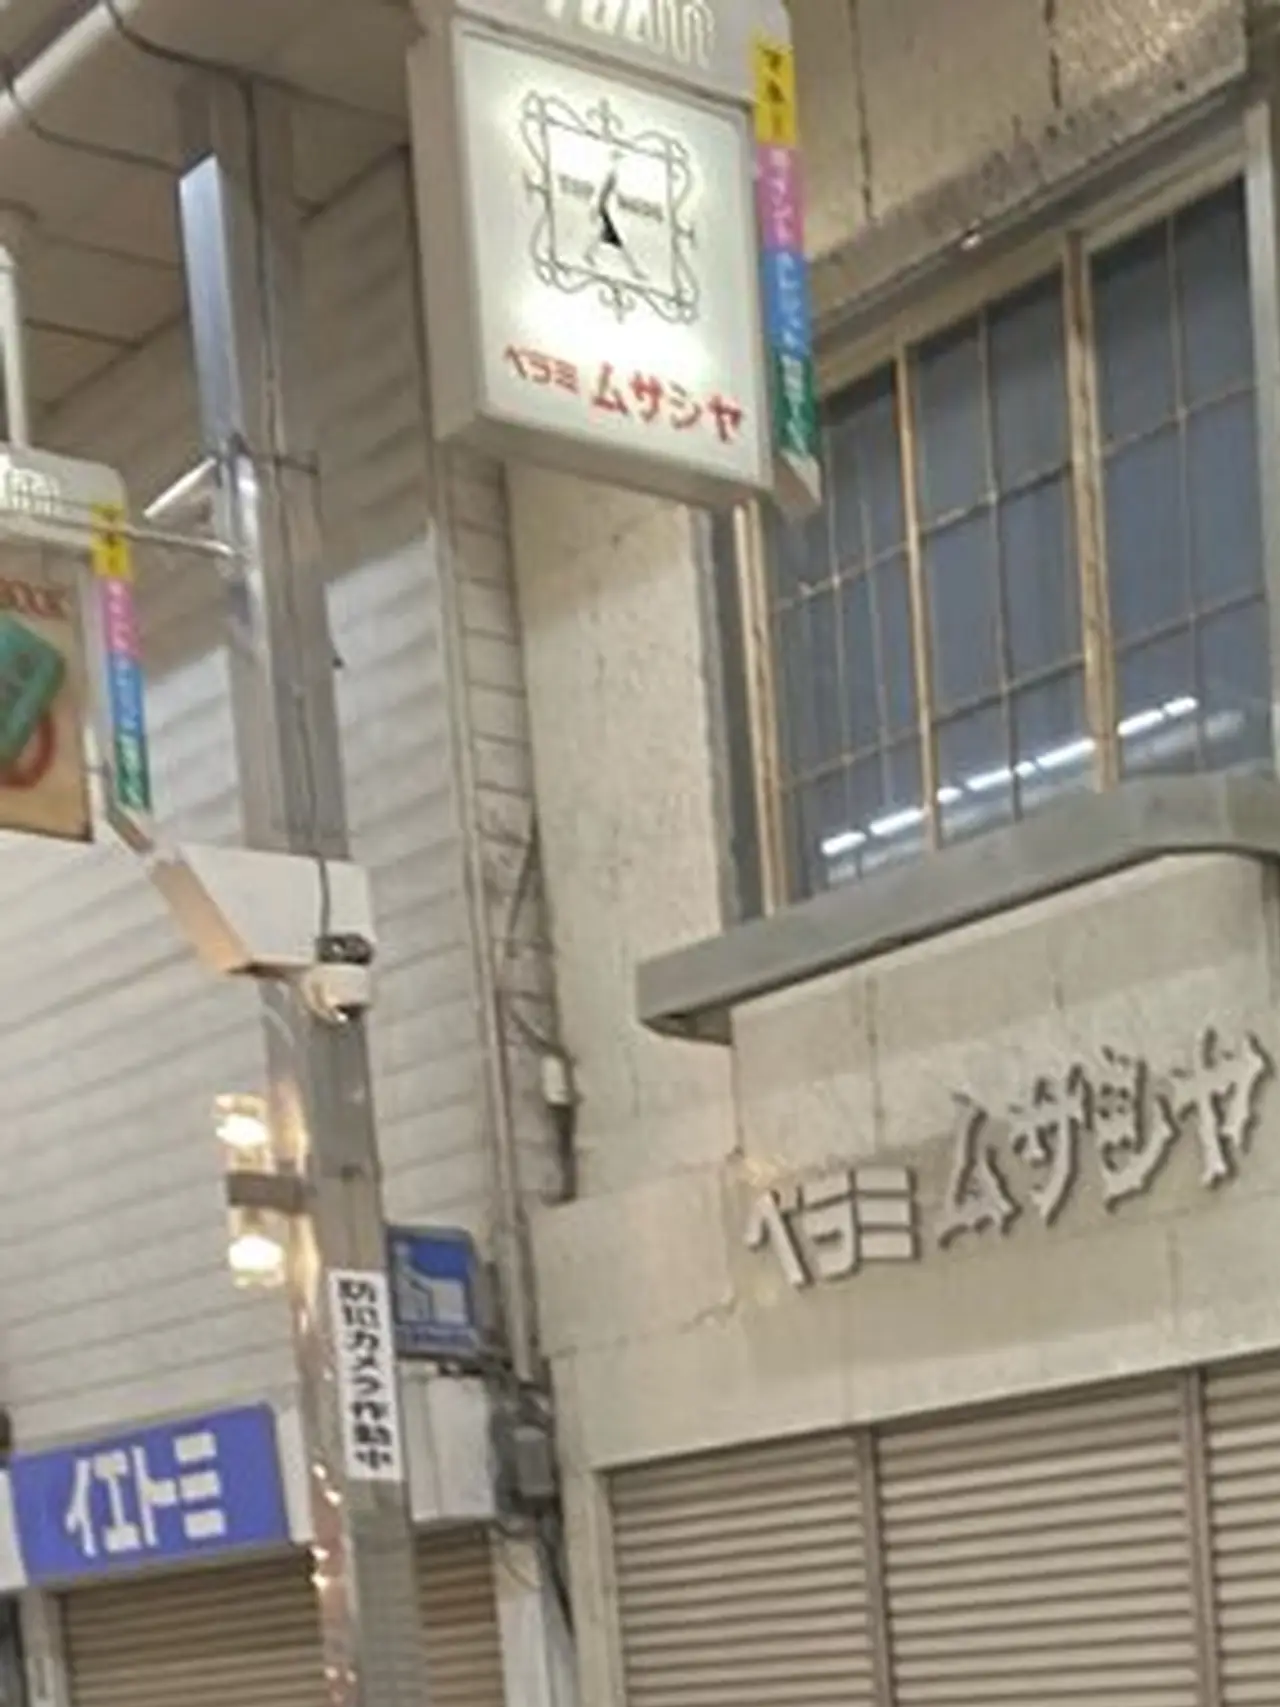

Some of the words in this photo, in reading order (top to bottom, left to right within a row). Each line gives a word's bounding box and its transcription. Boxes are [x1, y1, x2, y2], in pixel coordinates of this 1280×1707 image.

[592, 362, 742, 442] ムサシヤ
[937, 1026, 1274, 1250] ムサシヤ
[65, 1430, 227, 1558] イエトミ
